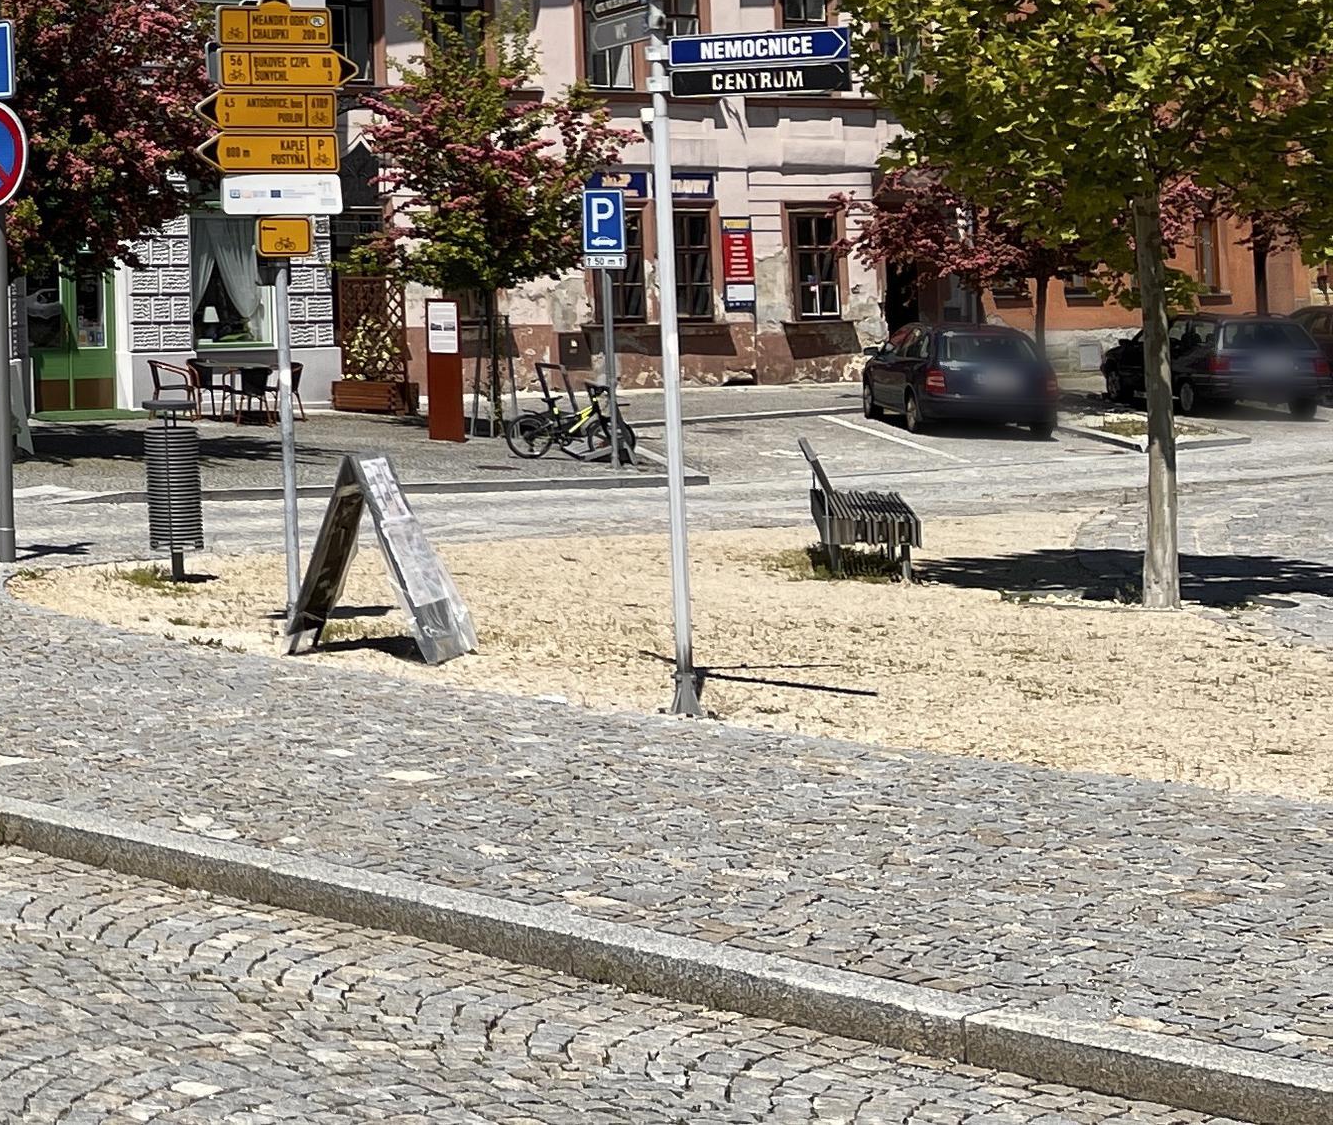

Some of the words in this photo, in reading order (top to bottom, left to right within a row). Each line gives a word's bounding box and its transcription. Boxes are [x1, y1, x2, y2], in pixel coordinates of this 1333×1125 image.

[252, 14, 288, 26] MEANDRY
[302, 29, 317, 40] 200
[700, 35, 813, 59] NEMOCNICE
[229, 55, 243, 66] 56
[253, 56, 287, 68] BUKOVEC
[327, 71, 333, 82] 3
[711, 70, 804, 91] CENTRUM
[280, 140, 305, 152] KAPLE
[317, 139, 326, 151] P
[590, 197, 615, 233] P
[594, 256, 605, 266] 50
